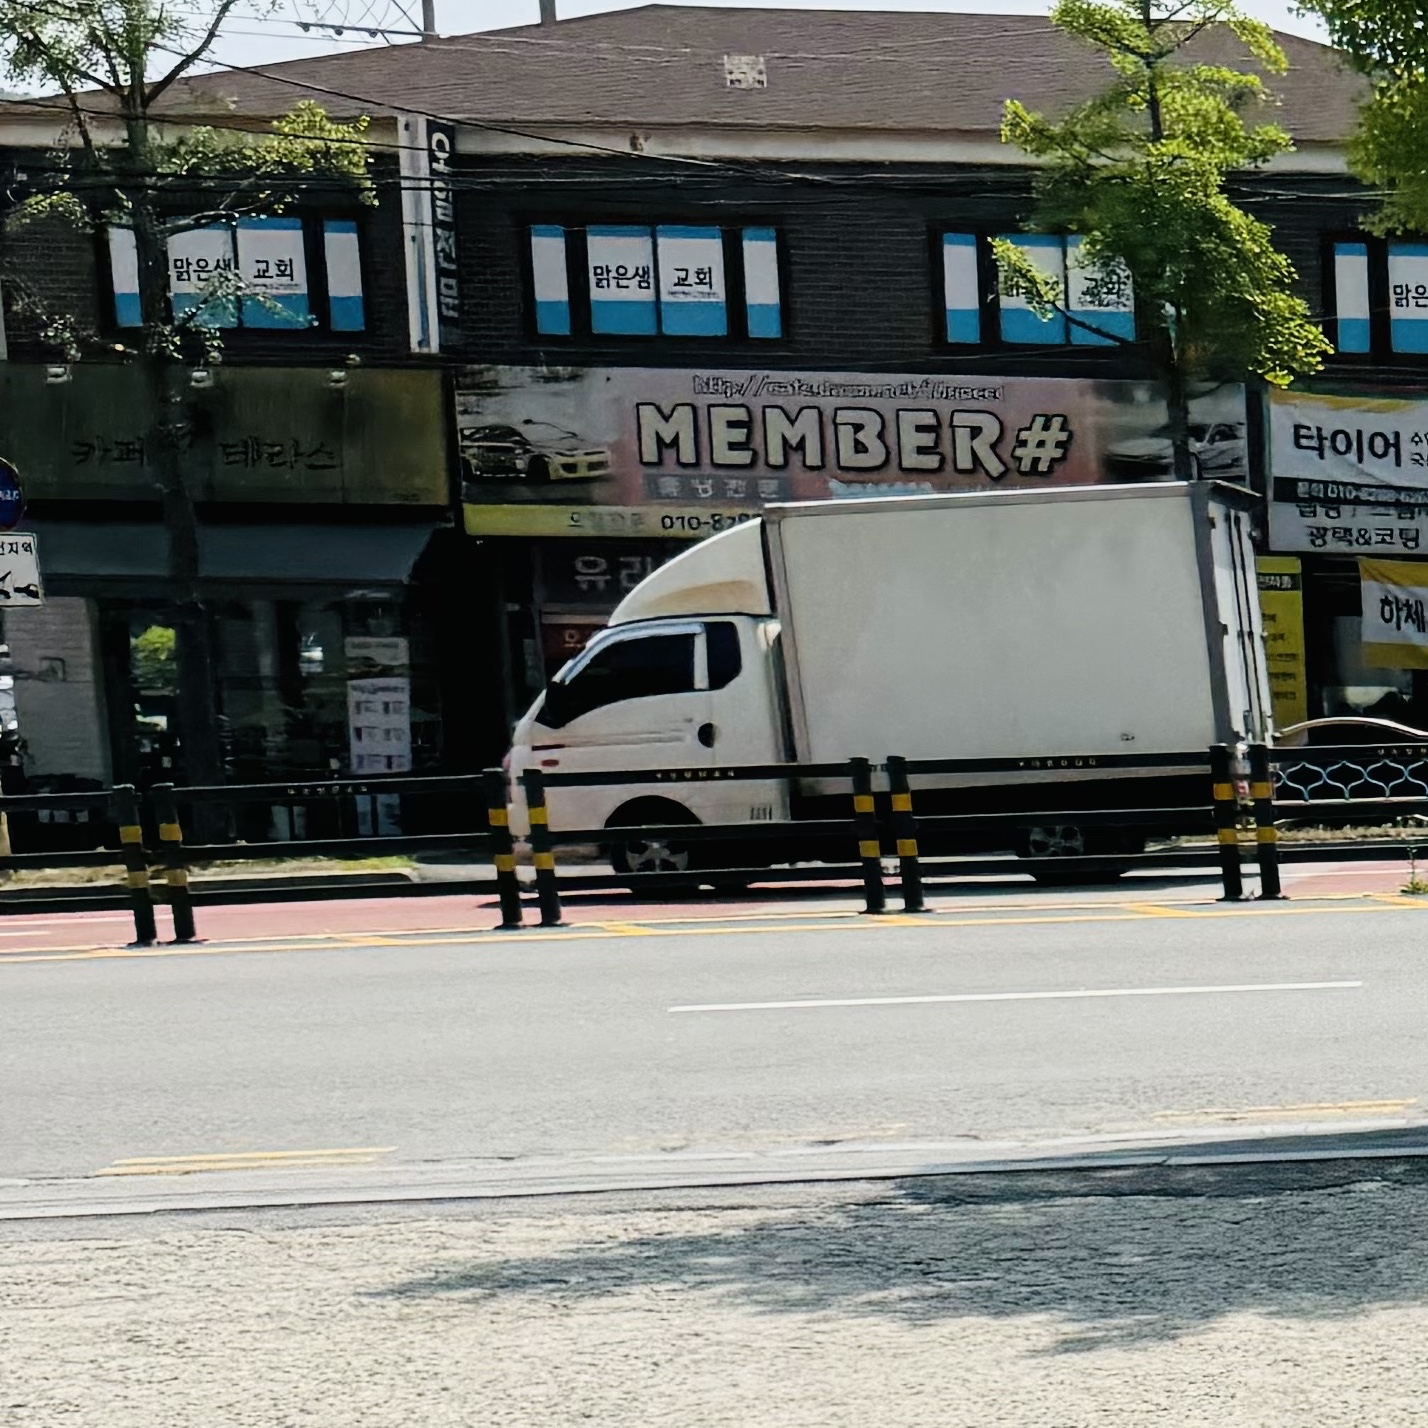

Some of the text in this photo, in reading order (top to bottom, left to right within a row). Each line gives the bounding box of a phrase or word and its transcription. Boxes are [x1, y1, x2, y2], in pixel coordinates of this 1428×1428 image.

[253, 257, 294, 281] 교회
[592, 264, 713, 290] 맑은샘 교회
[635, 401, 1074, 483] MEMBER#
[1293, 423, 1402, 468] 타이어
[0, 541, 34, 556] 지역
